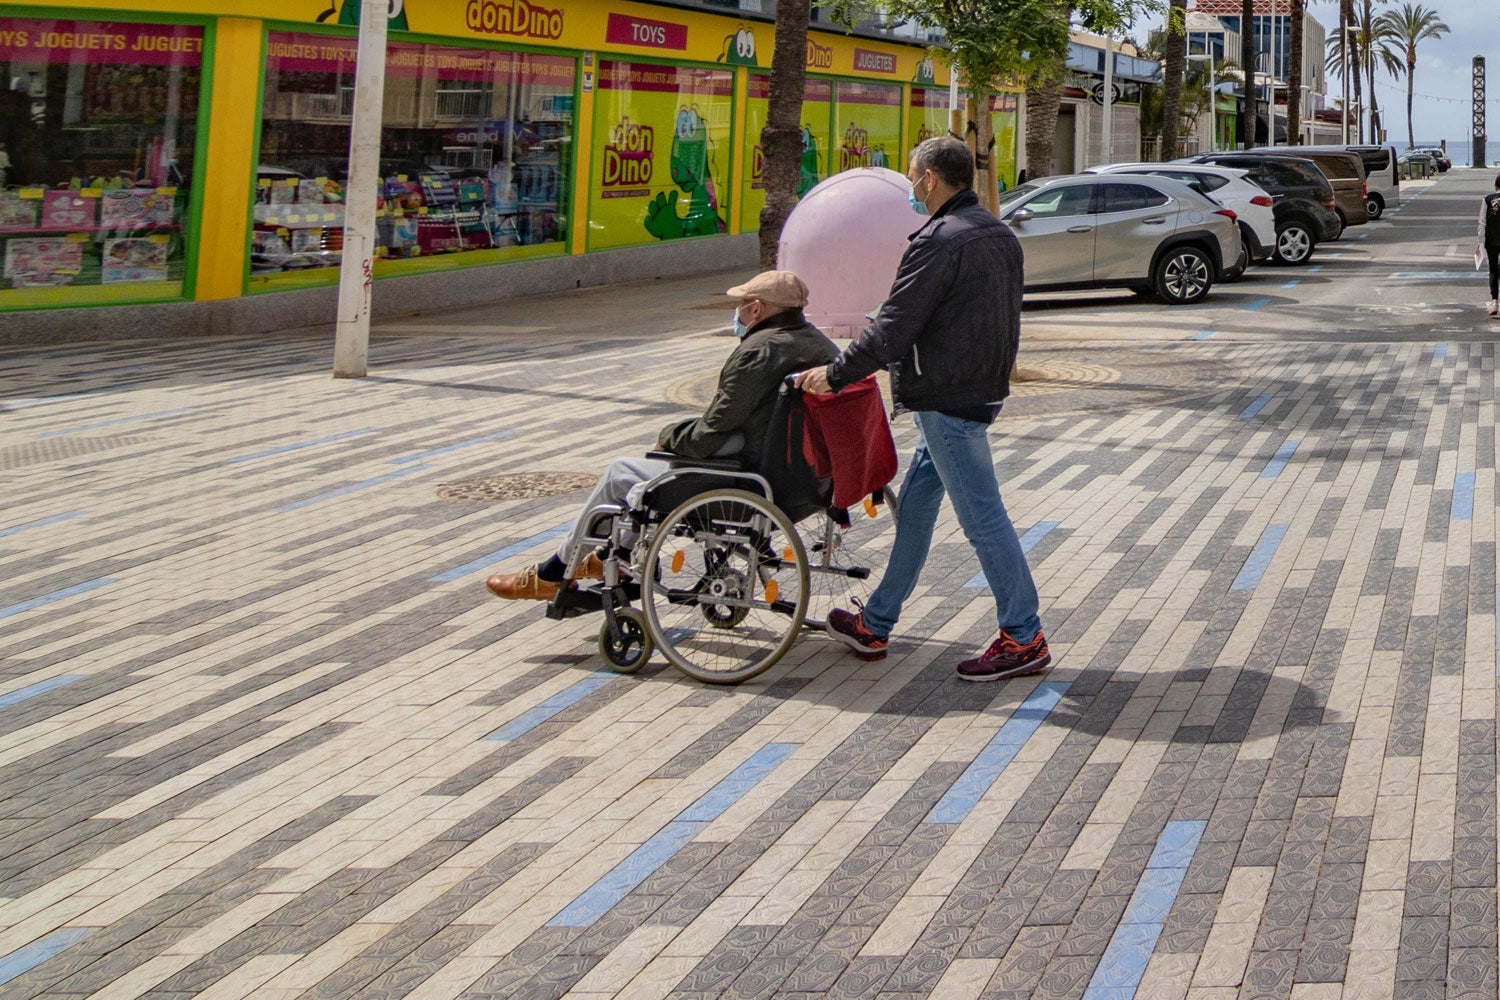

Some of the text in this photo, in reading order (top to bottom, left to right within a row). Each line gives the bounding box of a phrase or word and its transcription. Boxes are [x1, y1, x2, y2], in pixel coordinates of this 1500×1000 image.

[34, 32, 126, 50] JOGUETS
[631, 22, 666, 44] TOYS
[320, 47, 344, 61] TOYS
[390, 53, 434, 68] JUGUETES
[437, 55, 457, 69] TOYS
[858, 52, 893, 71] JUGUETES
[615, 116, 654, 152] don
[602, 145, 652, 186] Dino
